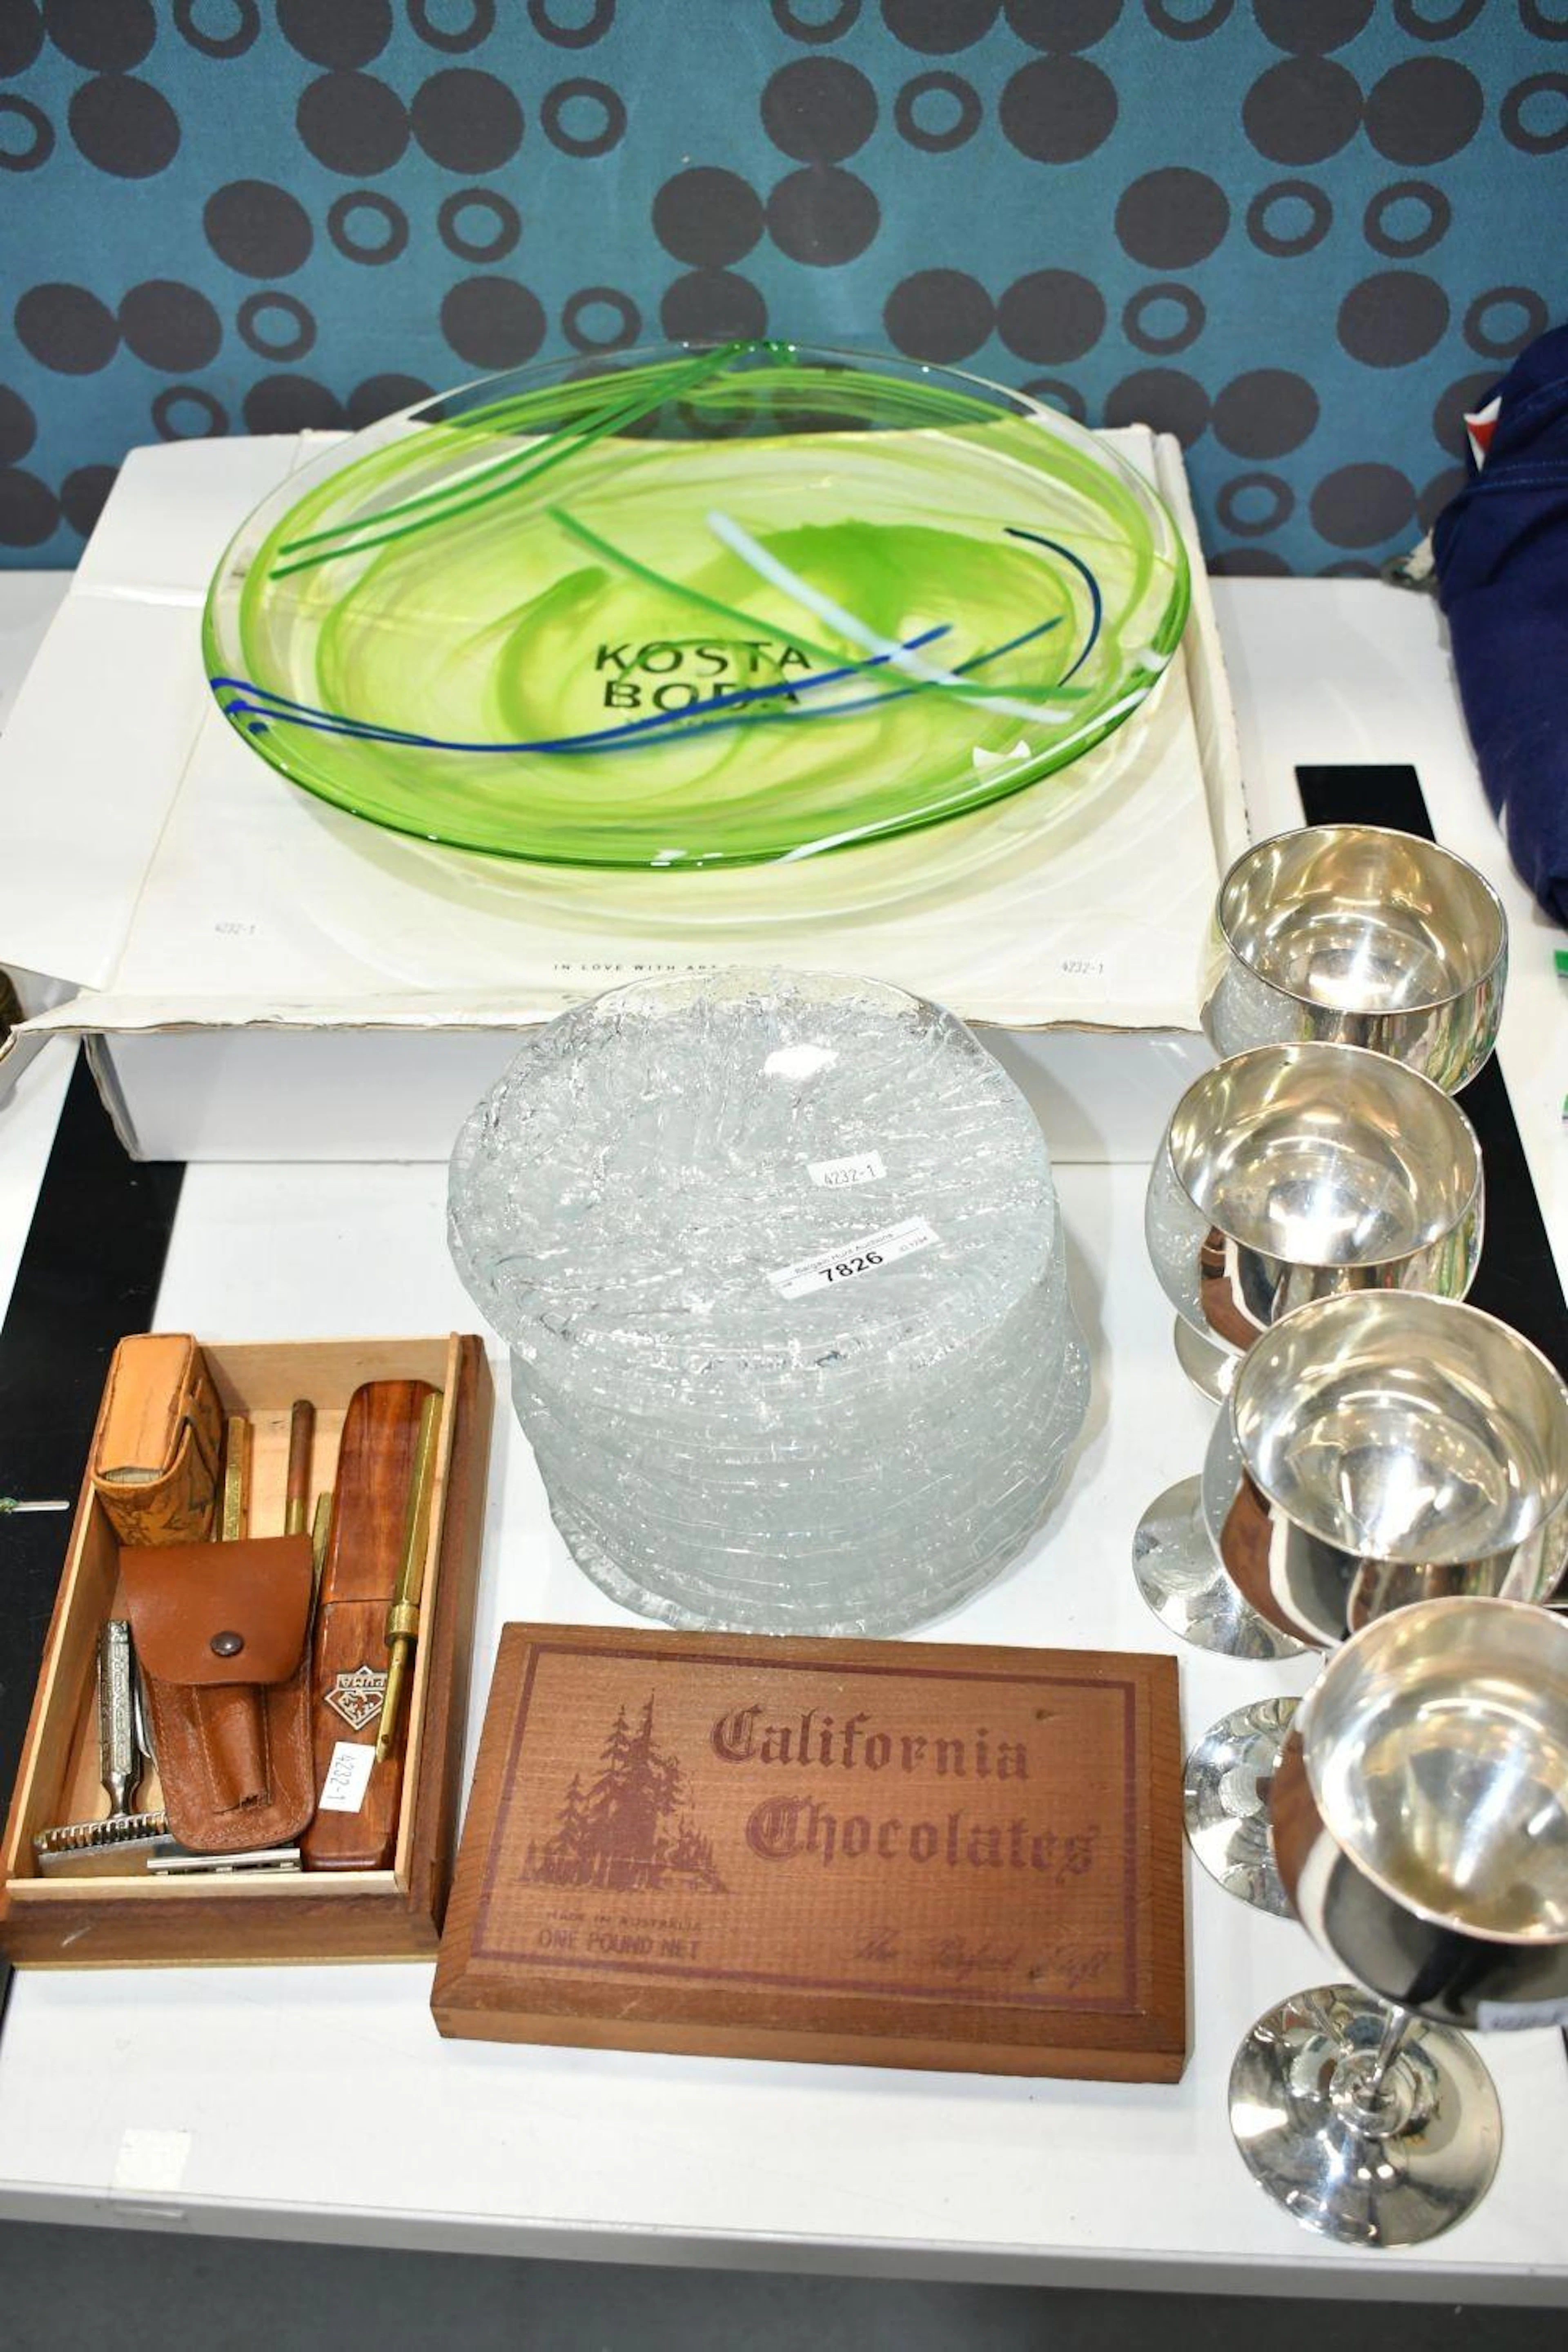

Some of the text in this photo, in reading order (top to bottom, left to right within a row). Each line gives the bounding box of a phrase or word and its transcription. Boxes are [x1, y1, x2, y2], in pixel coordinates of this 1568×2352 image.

[595, 641, 811, 677] KOSTA
[824, 1164, 875, 1185] 4232-1
[818, 1251, 883, 1282] 7826
[340, 1676, 385, 1688] PUMA
[710, 1704, 1030, 1780] California
[326, 1754, 357, 1800] 4232-1
[745, 1795, 1102, 1876] Chocolates
[587, 1931, 654, 1955] POUND
[660, 1938, 703, 1960] NET
